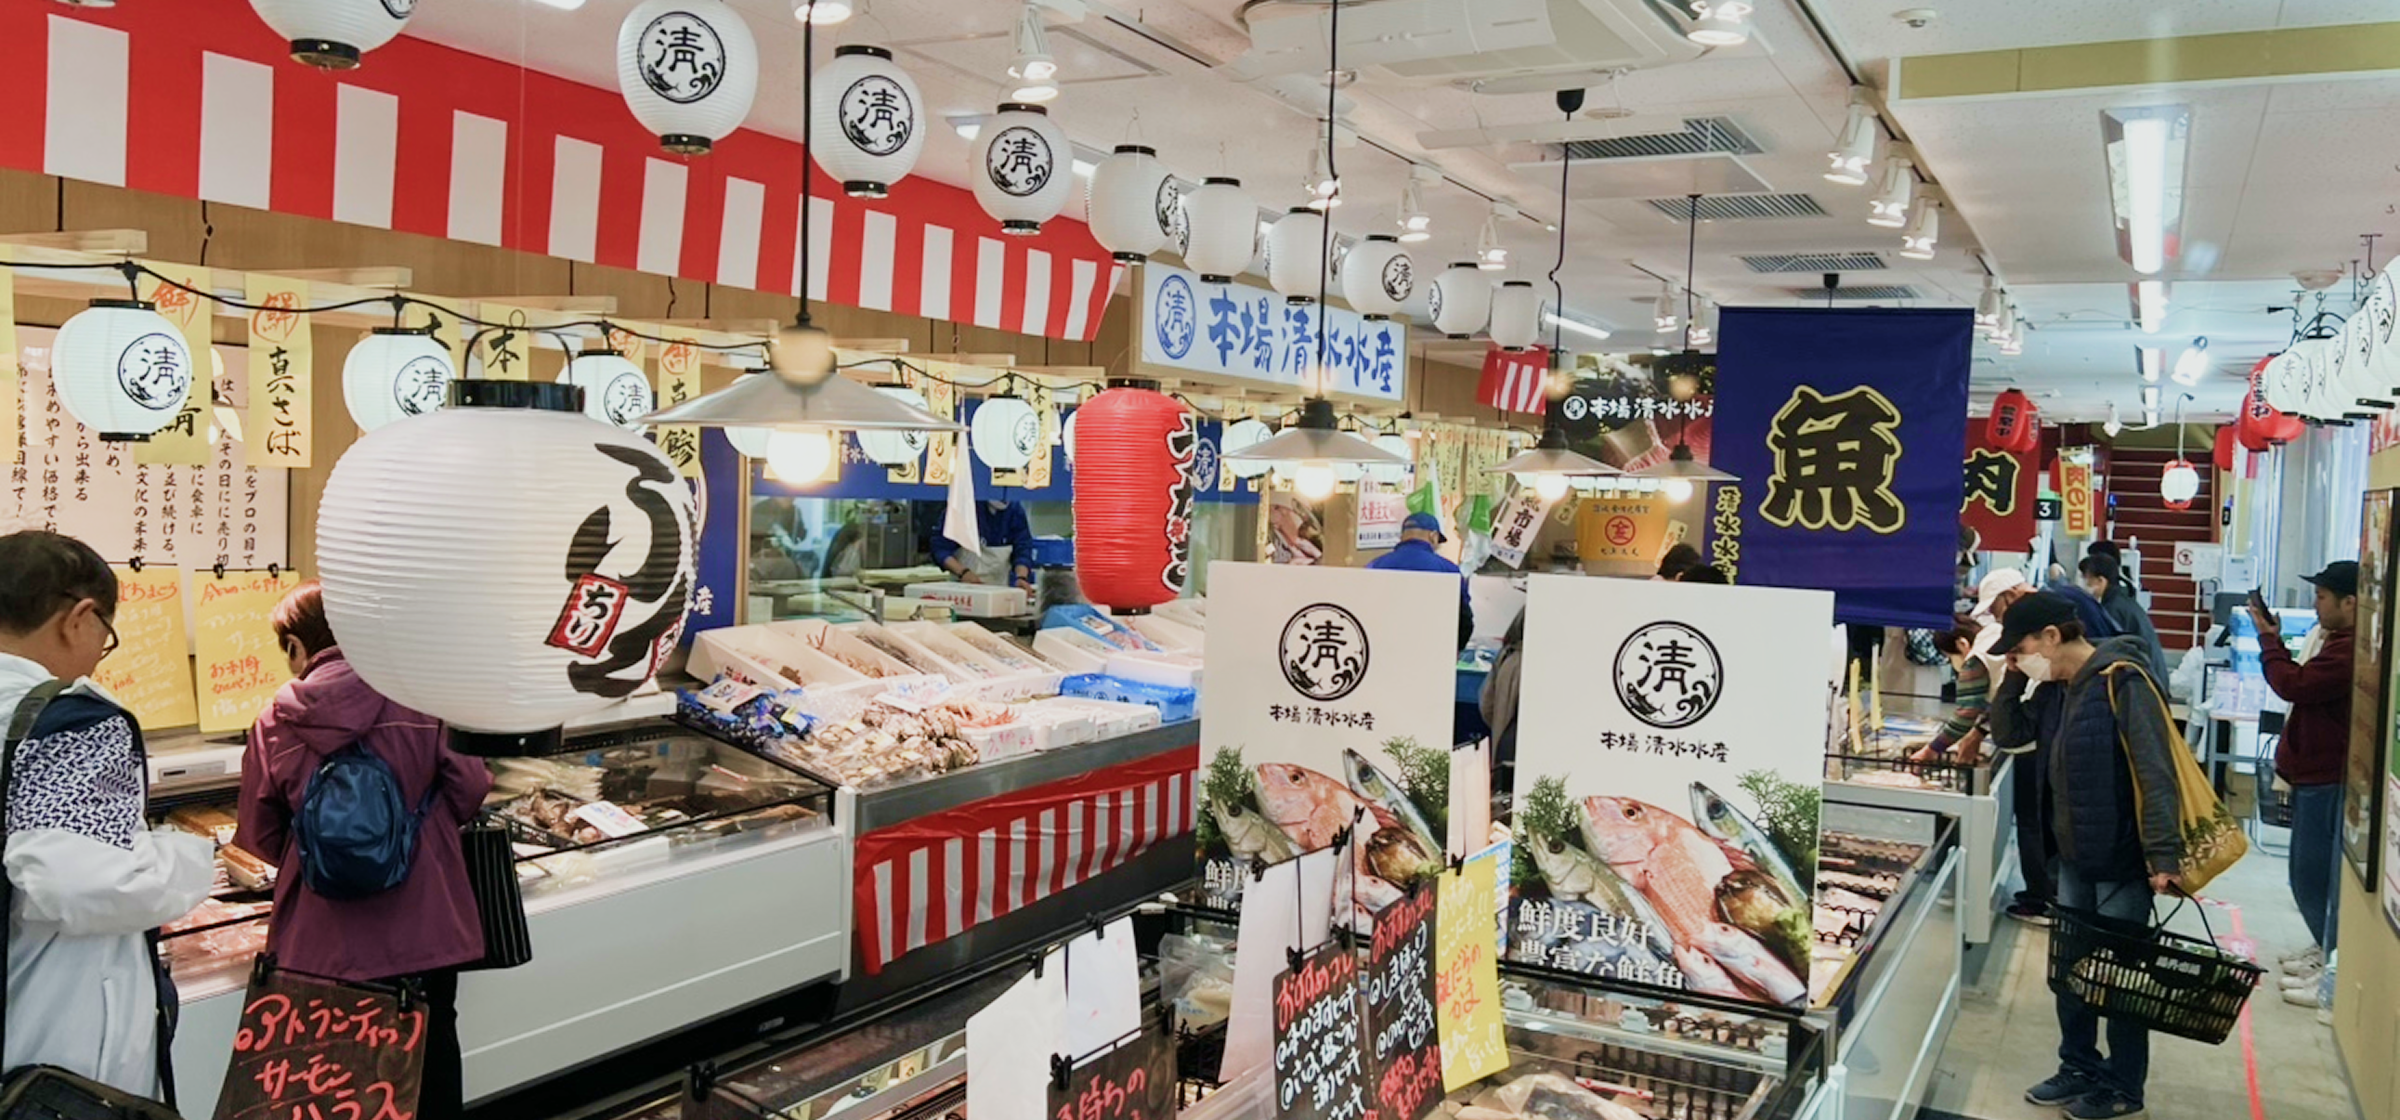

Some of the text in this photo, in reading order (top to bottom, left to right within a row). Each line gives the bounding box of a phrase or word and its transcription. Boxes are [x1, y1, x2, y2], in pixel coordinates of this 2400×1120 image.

[1208, 287, 1396, 393] 本場清水水産
[264, 346, 303, 456] 真さば
[1758, 384, 1905, 534] 魚
[1959, 448, 2019, 515] 肉
[2038, 501, 2051, 518] 3
[2065, 466, 2087, 531] 肉の日
[1269, 703, 1375, 732] 本場 清水水産
[1600, 729, 1730, 764] 本場 清水水産
[1517, 898, 1655, 952] 鮮度良好
[255, 1054, 352, 1099] サーモン
